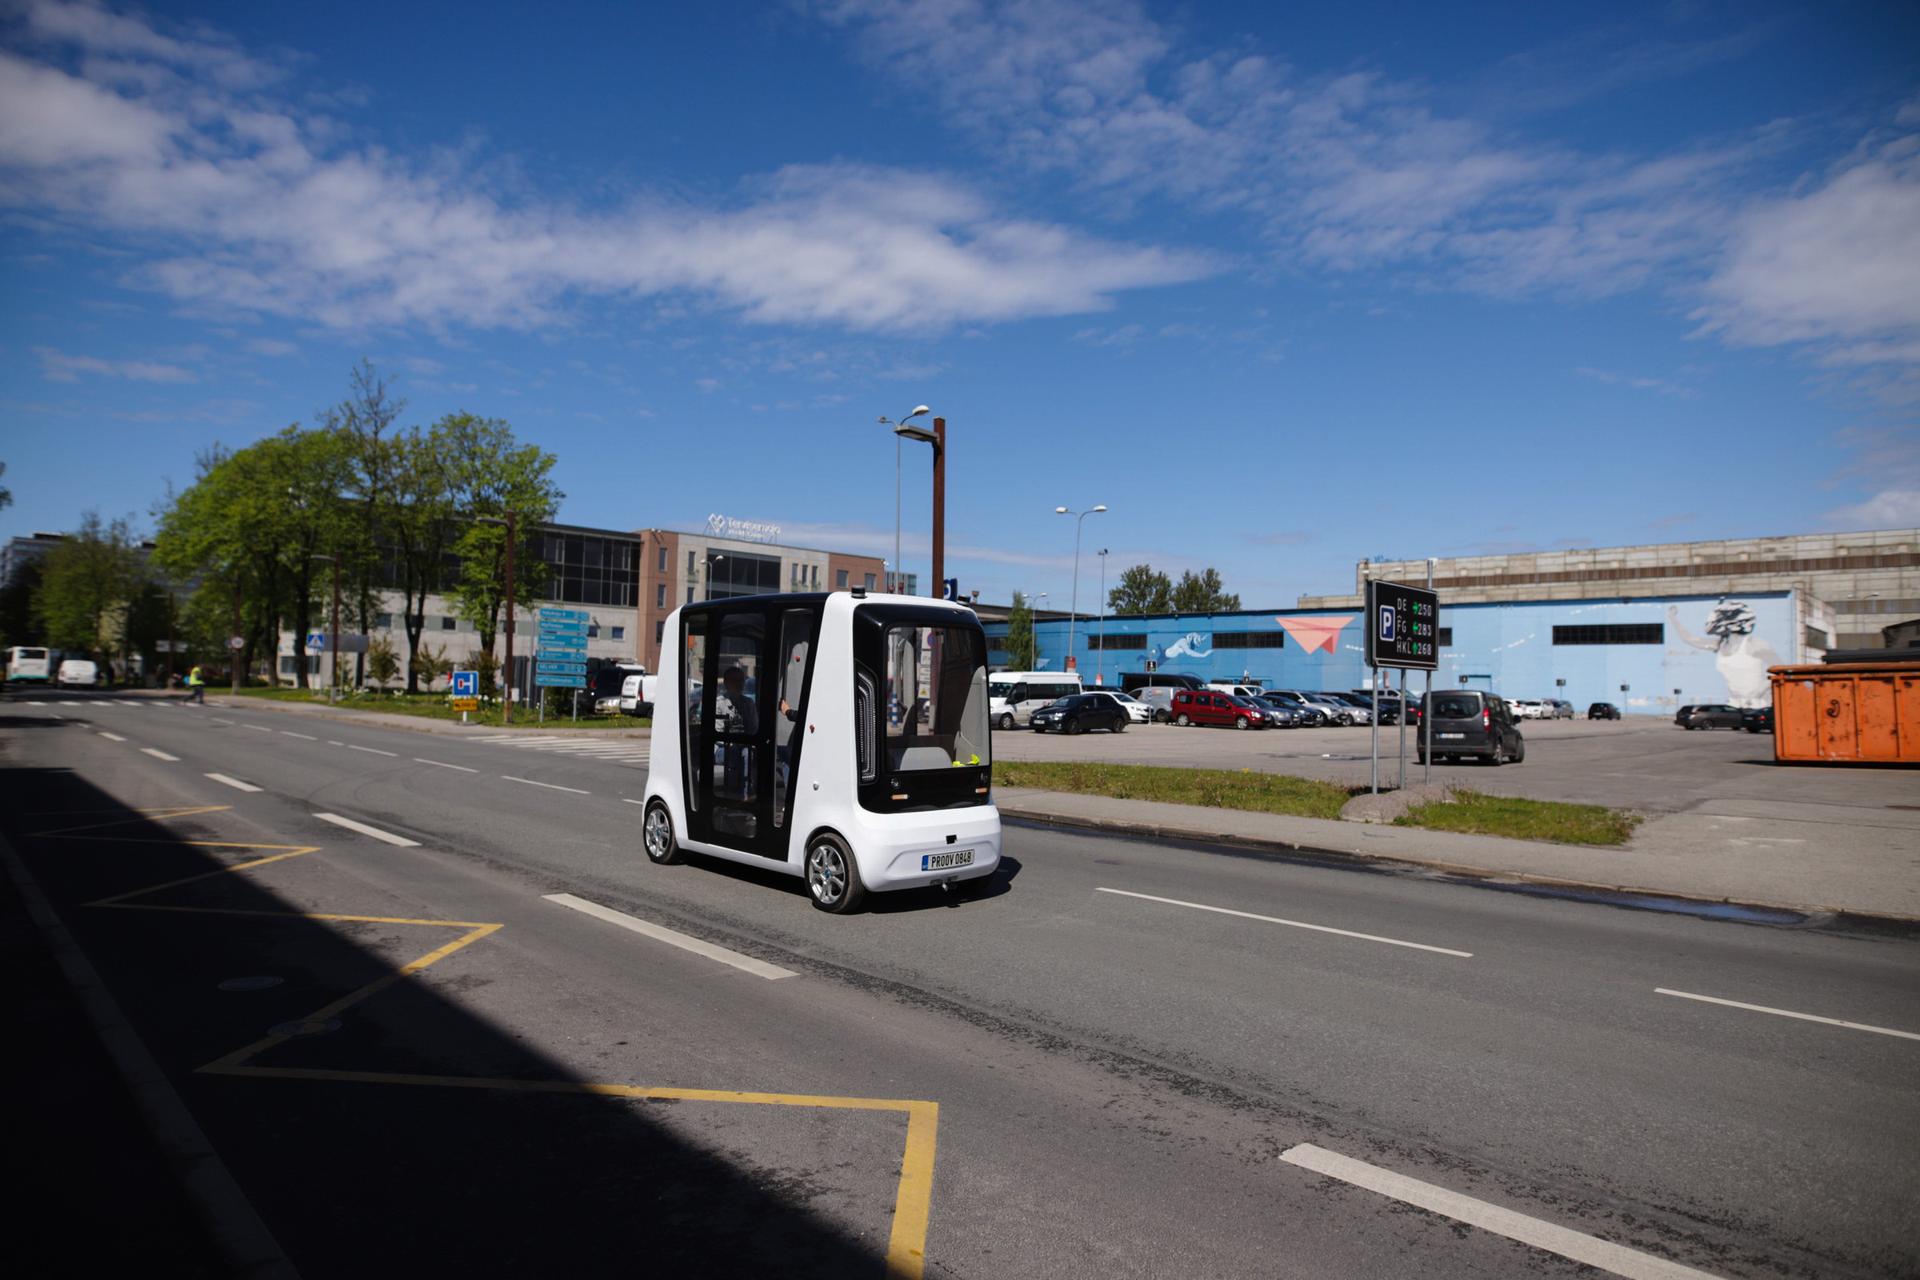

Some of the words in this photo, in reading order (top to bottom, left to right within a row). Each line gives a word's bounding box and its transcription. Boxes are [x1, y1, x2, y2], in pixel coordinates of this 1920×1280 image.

[1397, 598, 1407, 611] DE
[1418, 603, 1432, 616] 250
[1383, 612, 1392, 634] P
[1396, 620, 1407, 633] FG
[1418, 623, 1432, 636] 283
[1396, 641, 1411, 654] HKL
[1418, 643, 1432, 655] 268
[932, 854, 954, 867] PROOV
[955, 852, 971, 864] 0848
